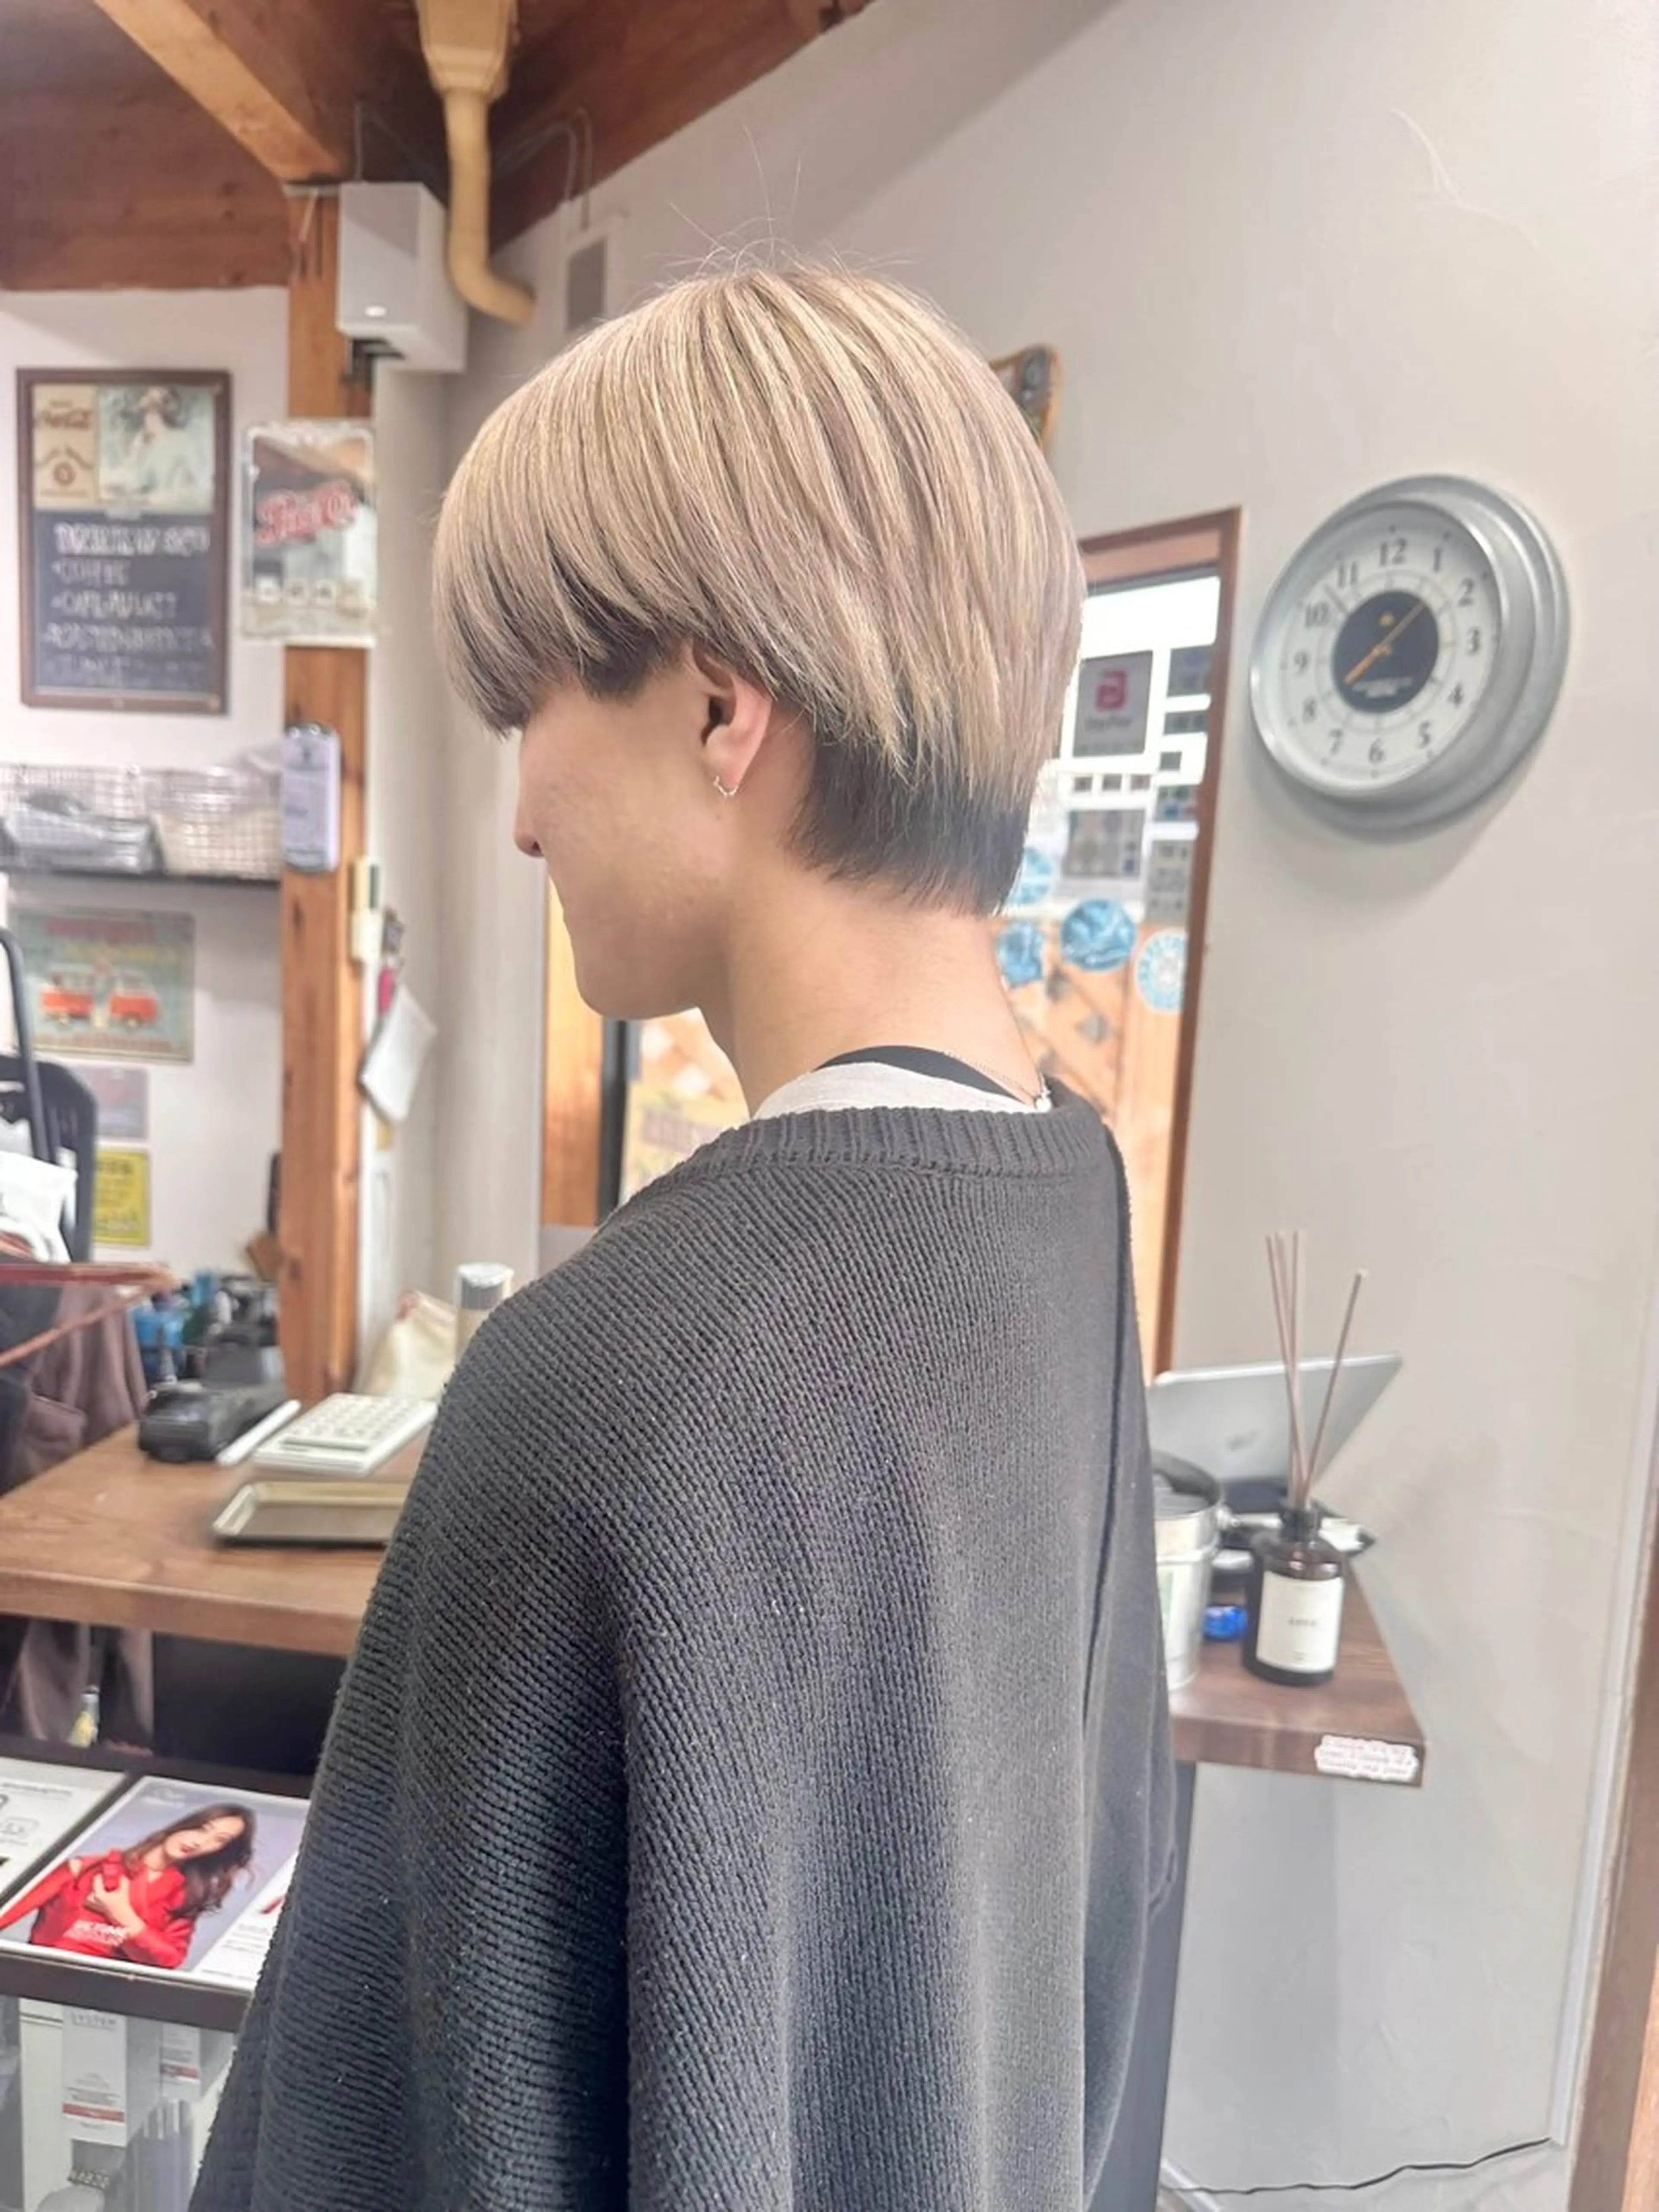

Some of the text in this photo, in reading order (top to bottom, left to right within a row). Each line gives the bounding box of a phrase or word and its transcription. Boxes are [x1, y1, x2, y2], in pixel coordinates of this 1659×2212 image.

[1379, 538, 1407, 568] 12
[1433, 546, 1442, 573] 1
[1337, 561, 1358, 588] 11
[1458, 577, 1475, 607] 2
[1304, 601, 1331, 628] 10
[1466, 628, 1481, 657] 3
[1293, 651, 1309, 675] 9
[1447, 681, 1465, 708] 4
[1302, 696, 1316, 723] 8
[1328, 728, 1344, 755] 7
[1417, 720, 1431, 750] 5
[1368, 737, 1386, 764] 6
